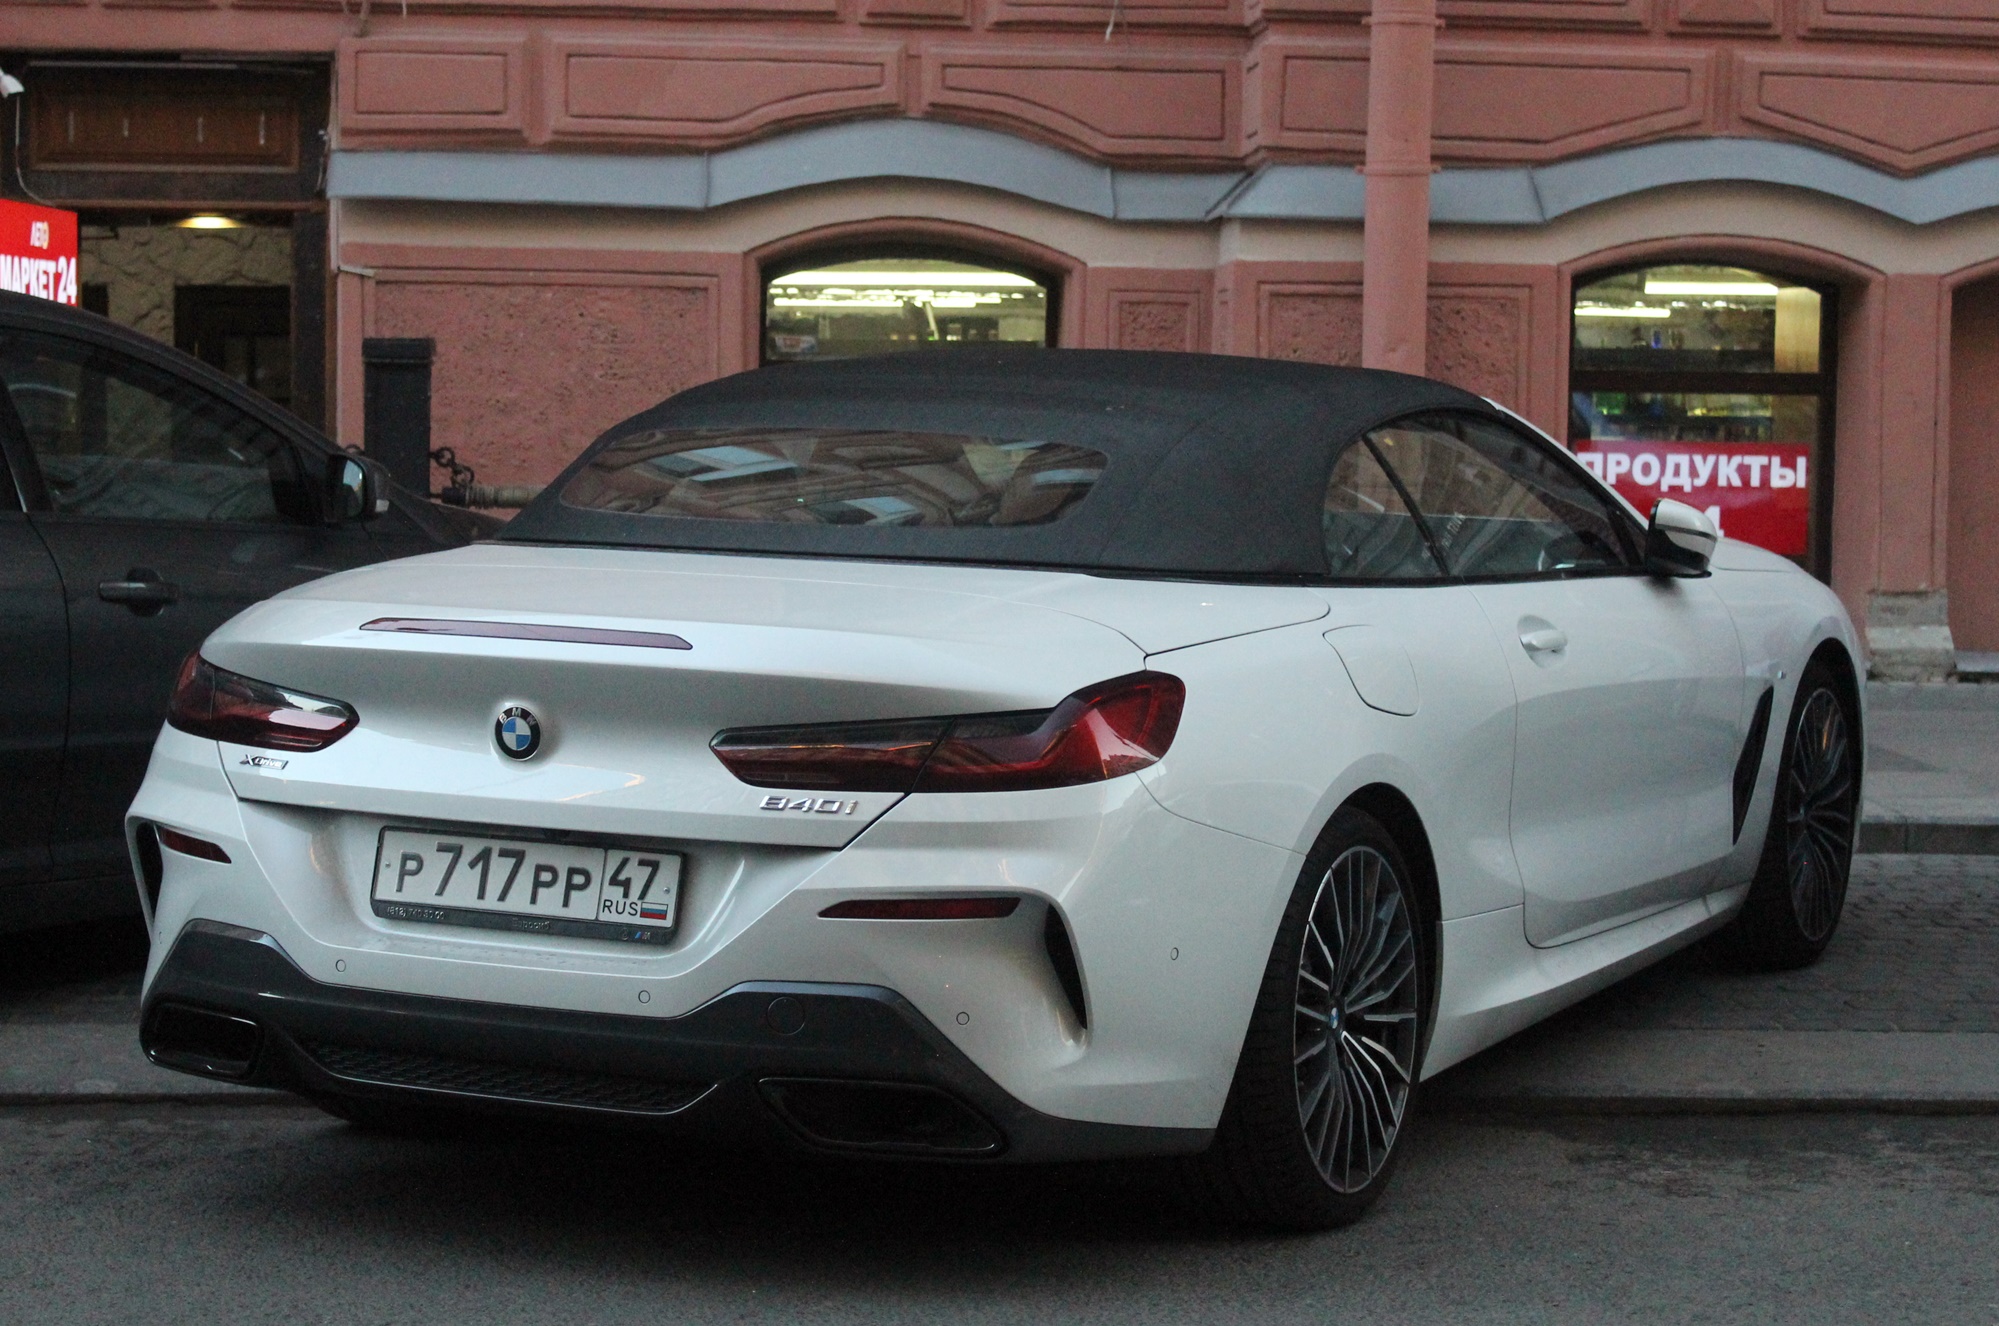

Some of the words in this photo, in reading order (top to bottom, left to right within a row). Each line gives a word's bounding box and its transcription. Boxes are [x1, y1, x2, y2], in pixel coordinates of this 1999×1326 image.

[1576, 452, 1807, 493] ПРОДУКТЫ
[498, 707, 538, 726] BMW
[759, 795, 858, 815] 840i
[608, 857, 660, 901] 47
[602, 899, 639, 917] RUS
